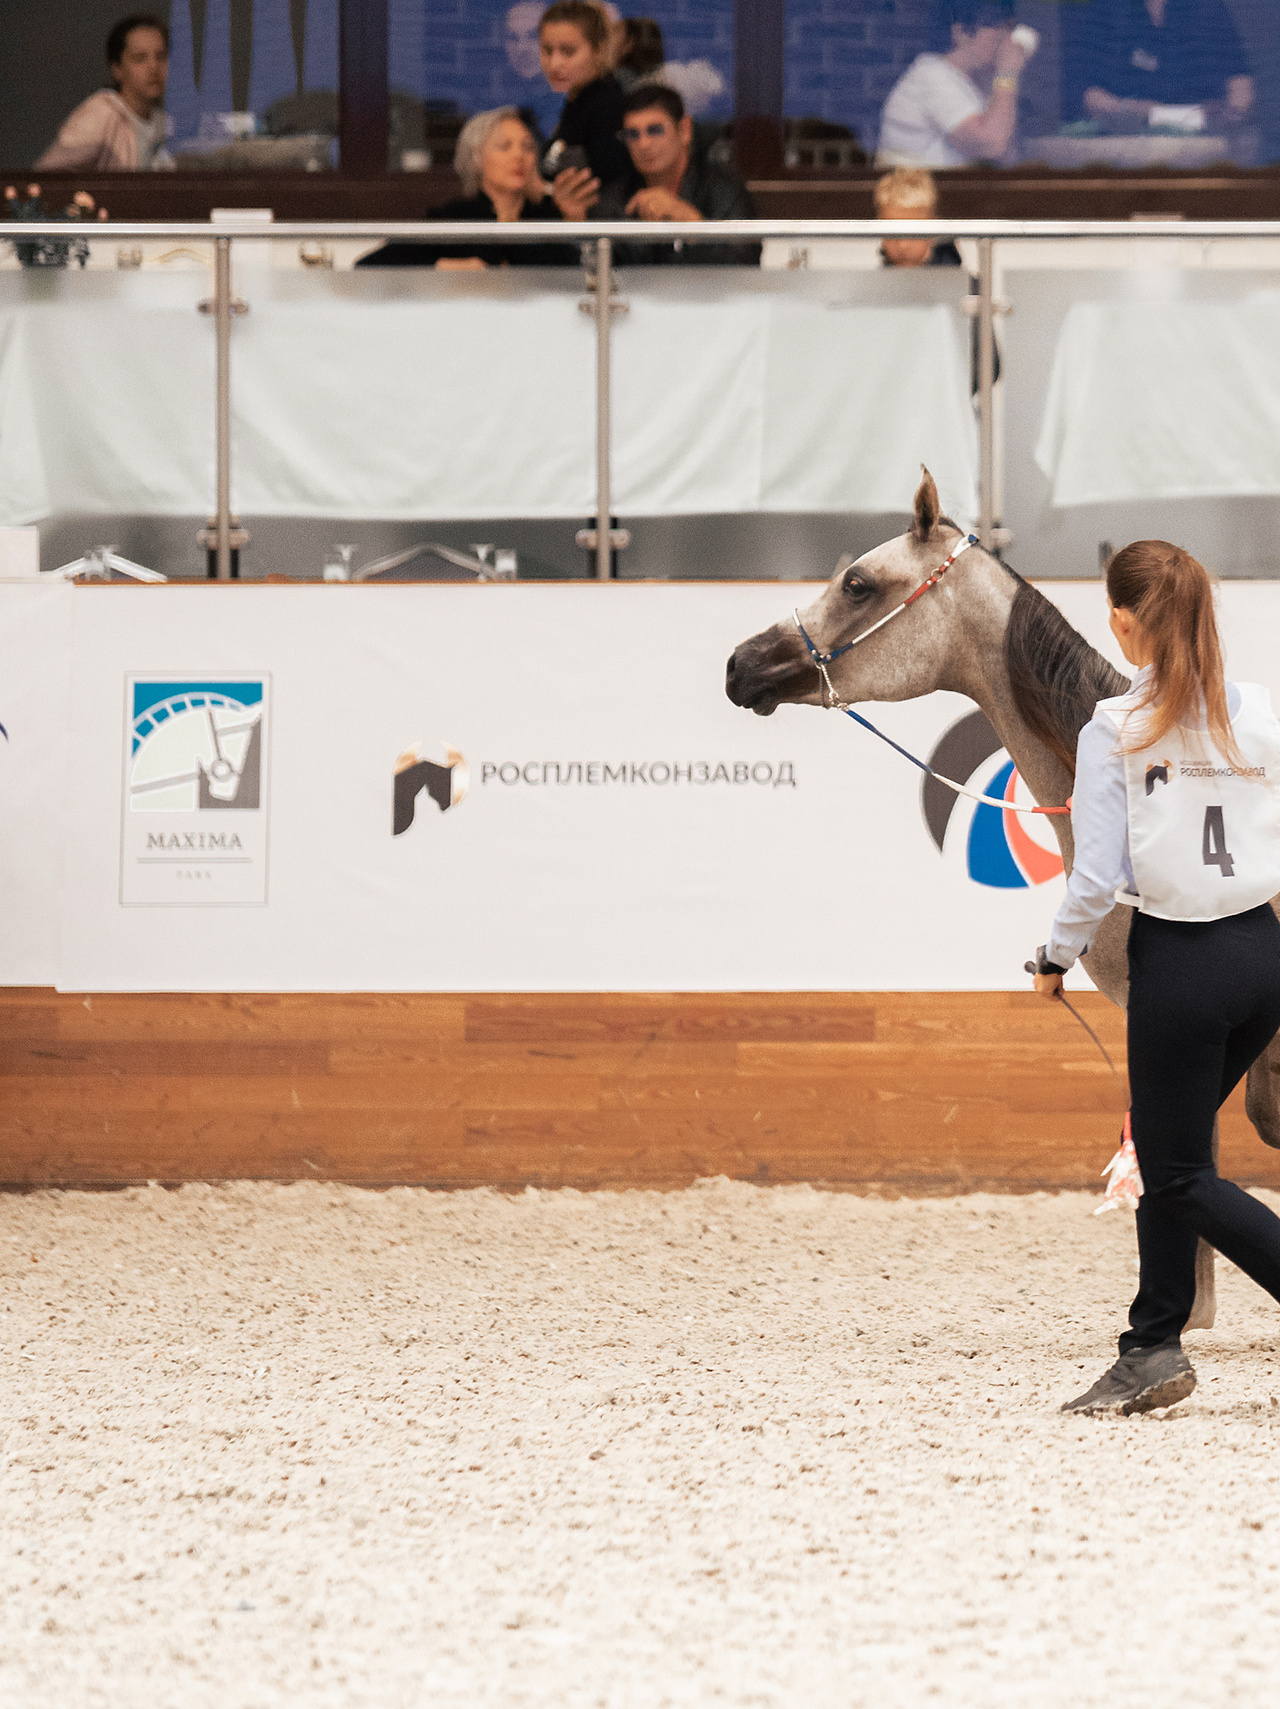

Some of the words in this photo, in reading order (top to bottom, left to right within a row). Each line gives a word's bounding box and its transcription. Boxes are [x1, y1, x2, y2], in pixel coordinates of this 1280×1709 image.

[481, 761, 796, 788] РОСПЛЕМКОНЗАВОД
[146, 832, 243, 850] MAXIMA
[1202, 805, 1235, 877] 4
